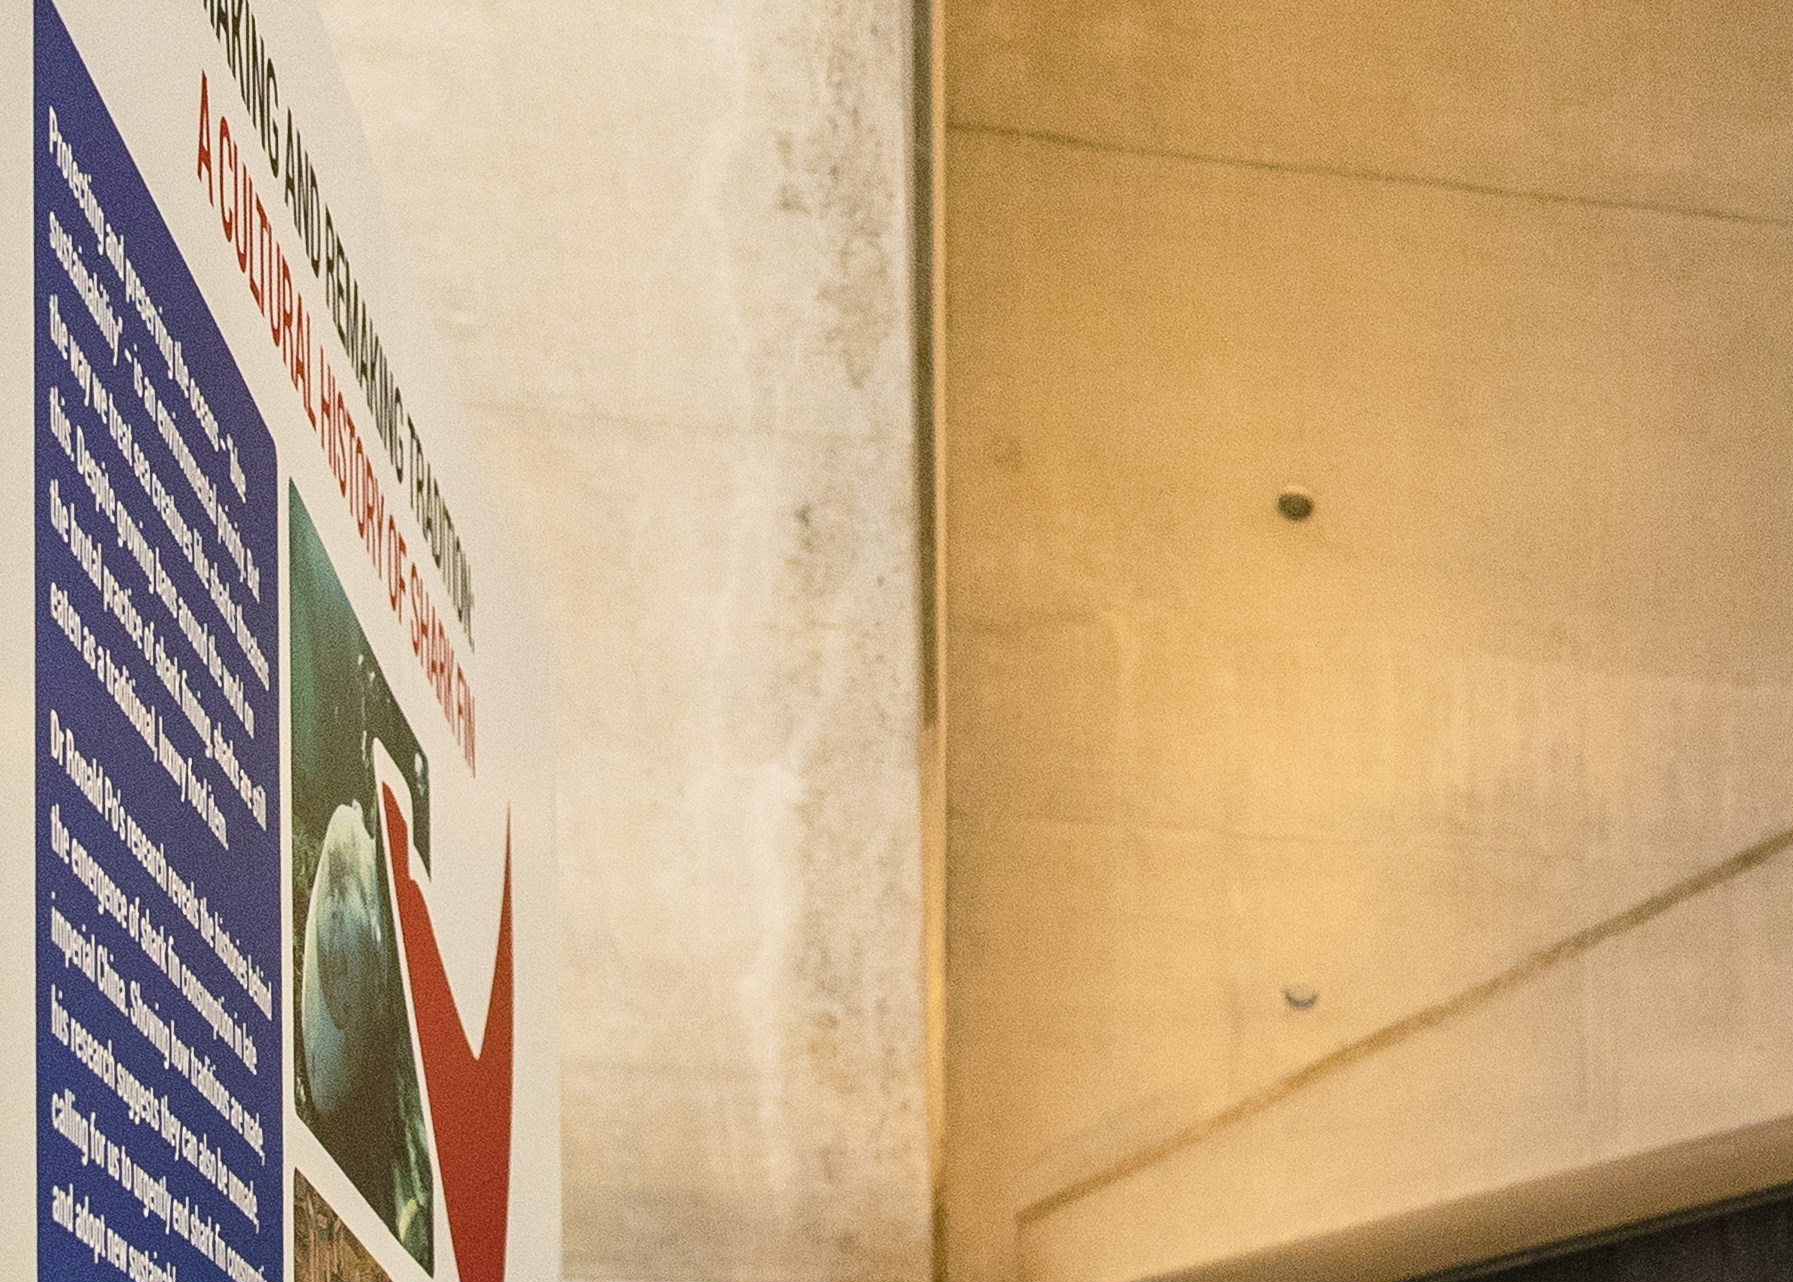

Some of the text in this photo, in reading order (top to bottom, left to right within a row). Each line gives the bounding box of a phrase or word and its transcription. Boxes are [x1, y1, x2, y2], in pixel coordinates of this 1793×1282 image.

[49, 105, 104, 256] Protecting
[105, 222, 124, 282] and
[125, 257, 173, 380] preserving
[174, 340, 189, 398] the
[189, 377, 219, 452] oceans
[198, 69, 475, 779] A CULTURAL HISTORY OF SHARK FIN
[284, 107, 321, 278] AND
[325, 203, 404, 484] REMAKING
[49, 294, 68, 360] the
[69, 334, 91, 407] way
[92, 372, 107, 424] we
[108, 392, 132, 467] treat
[133, 442, 151, 496] sea
[151, 472, 193, 563] creatures
[193, 528, 209, 590] like
[209, 562, 236, 634] sharks
[49, 386, 74, 462] this.
[76, 425, 115, 524] Despite
[116, 500, 154, 595] growing
[155, 547, 177, 619] bans
[178, 596, 208, 666] around
[208, 634, 222, 688] the
[222, 664, 244, 722] world
[133, 343, 143, 398] is
[143, 375, 156, 421] an
[156, 398, 217, 525] environmental
[246, 547, 260, 603] But
[49, 479, 69, 543] the
[70, 504, 102, 591] brutal
[103, 565, 143, 650] practice
[143, 622, 154, 666] of
[155, 637, 181, 705] shark
[213, 722, 239, 790] sharks
[239, 768, 252, 809] are
[50, 581, 81, 652] eaten
[83, 625, 96, 670] as
[97, 645, 104, 683] a
[105, 648, 158, 762] traditional,
[158, 716, 187, 803] luxury
[187, 757, 207, 821] food
[50, 708, 64, 766] Dr
[65, 727, 103, 814] Ronald
[126, 814, 167, 891] research
[168, 865, 199, 930] reveals
[199, 897, 214, 948] the
[247, 954, 272, 1021] behind
[50, 804, 69, 865] the
[71, 837, 127, 929] emergence
[128, 897, 140, 942] of
[140, 909, 167, 974] shark
[167, 935, 180, 989] fin
[181, 963, 234, 1049] consumption
[234, 1011, 242, 1059] in
[51, 892, 265, 1166] imperial China. Showing how traditions are made,
[51, 984, 69, 1046] his
[70, 1017, 115, 1090] research
[116, 1062, 160, 1131] suggests
[160, 1094, 181, 1161] they
[181, 1125, 198, 1167] can
[198, 1132, 216, 1184] also
[217, 1146, 228, 1195] be
[51, 1090, 89, 1166] calling
[89, 1113, 106, 1168] for
[107, 1139, 120, 1181] us
[121, 1144, 132, 1191] to
[133, 1163, 171, 1235] urgently
[172, 1197, 189, 1240] end
[190, 1205, 214, 1261] shark
[214, 1223, 226, 1271] fin
[52, 1182, 73, 1232] and
[75, 1195, 106, 1264] adopt
[106, 1227, 127, 1273] new
